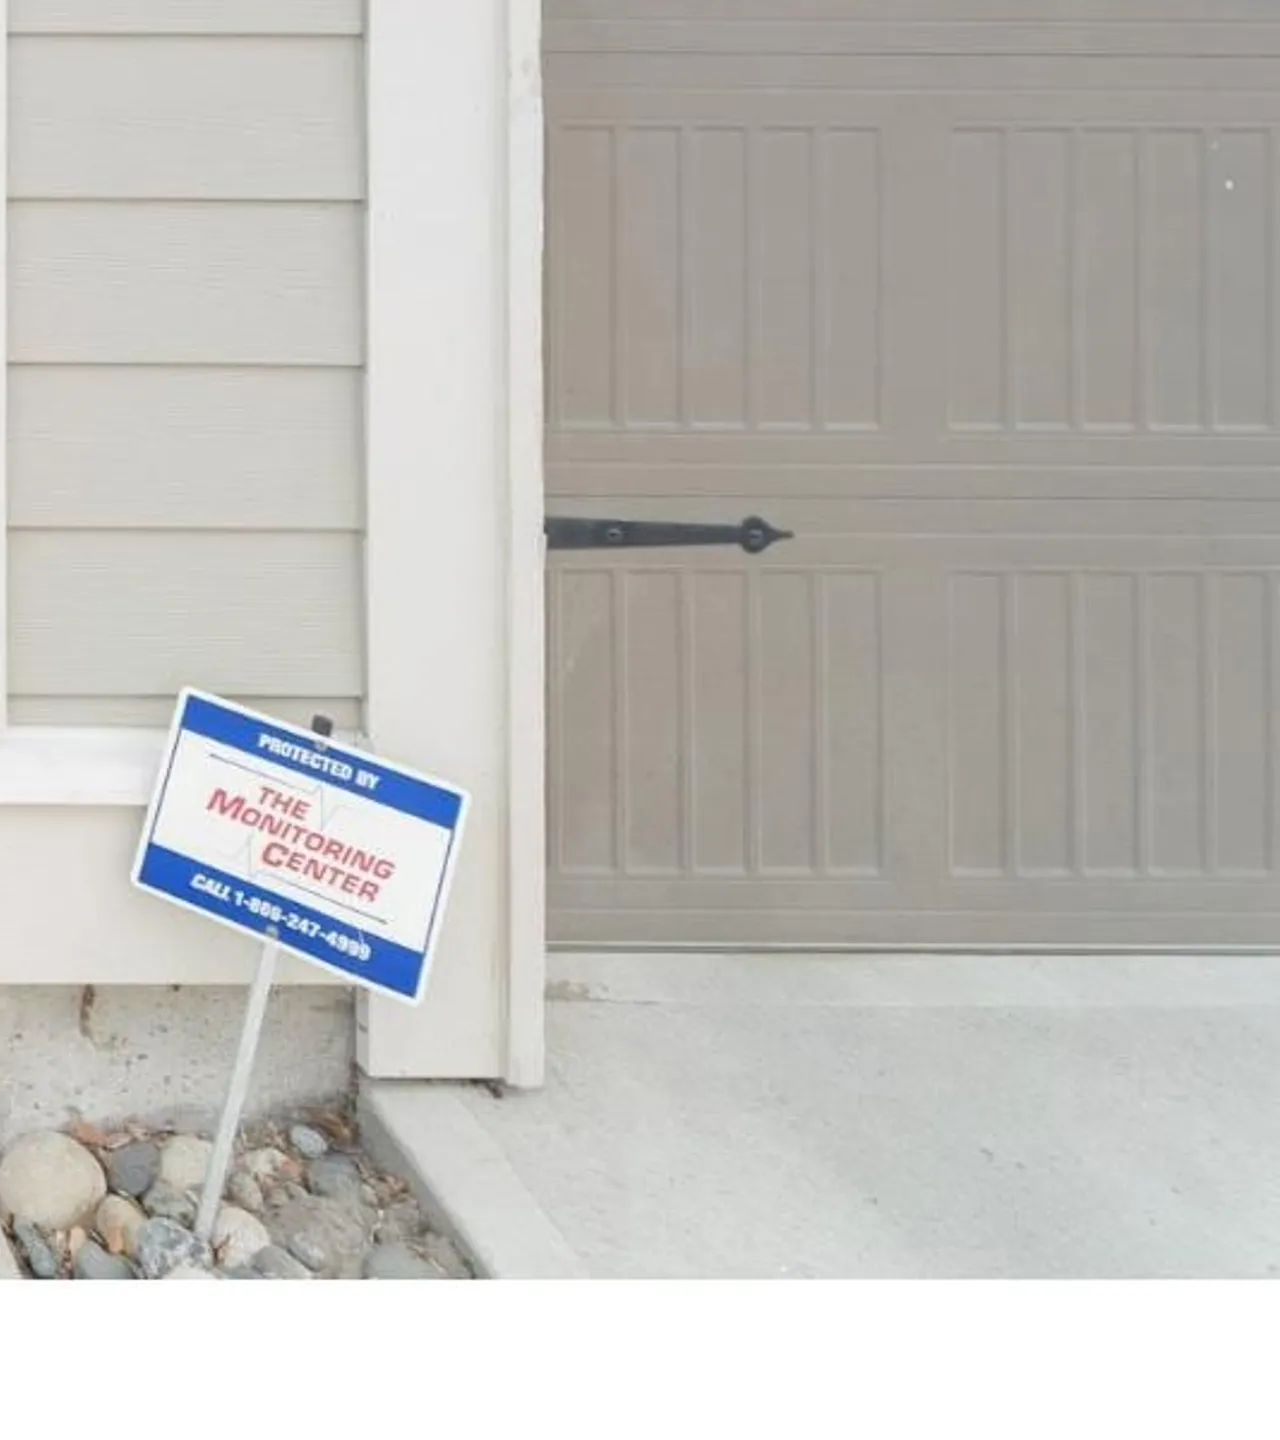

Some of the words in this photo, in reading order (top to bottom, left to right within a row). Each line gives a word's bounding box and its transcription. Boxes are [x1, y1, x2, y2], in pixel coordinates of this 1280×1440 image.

[257, 733, 352, 781] PROTECTED
[355, 769, 380, 790] BY
[259, 786, 312, 821] THE
[206, 788, 396, 881] MONITORING
[191, 873, 231, 902] CALL
[262, 842, 381, 903] CENTER
